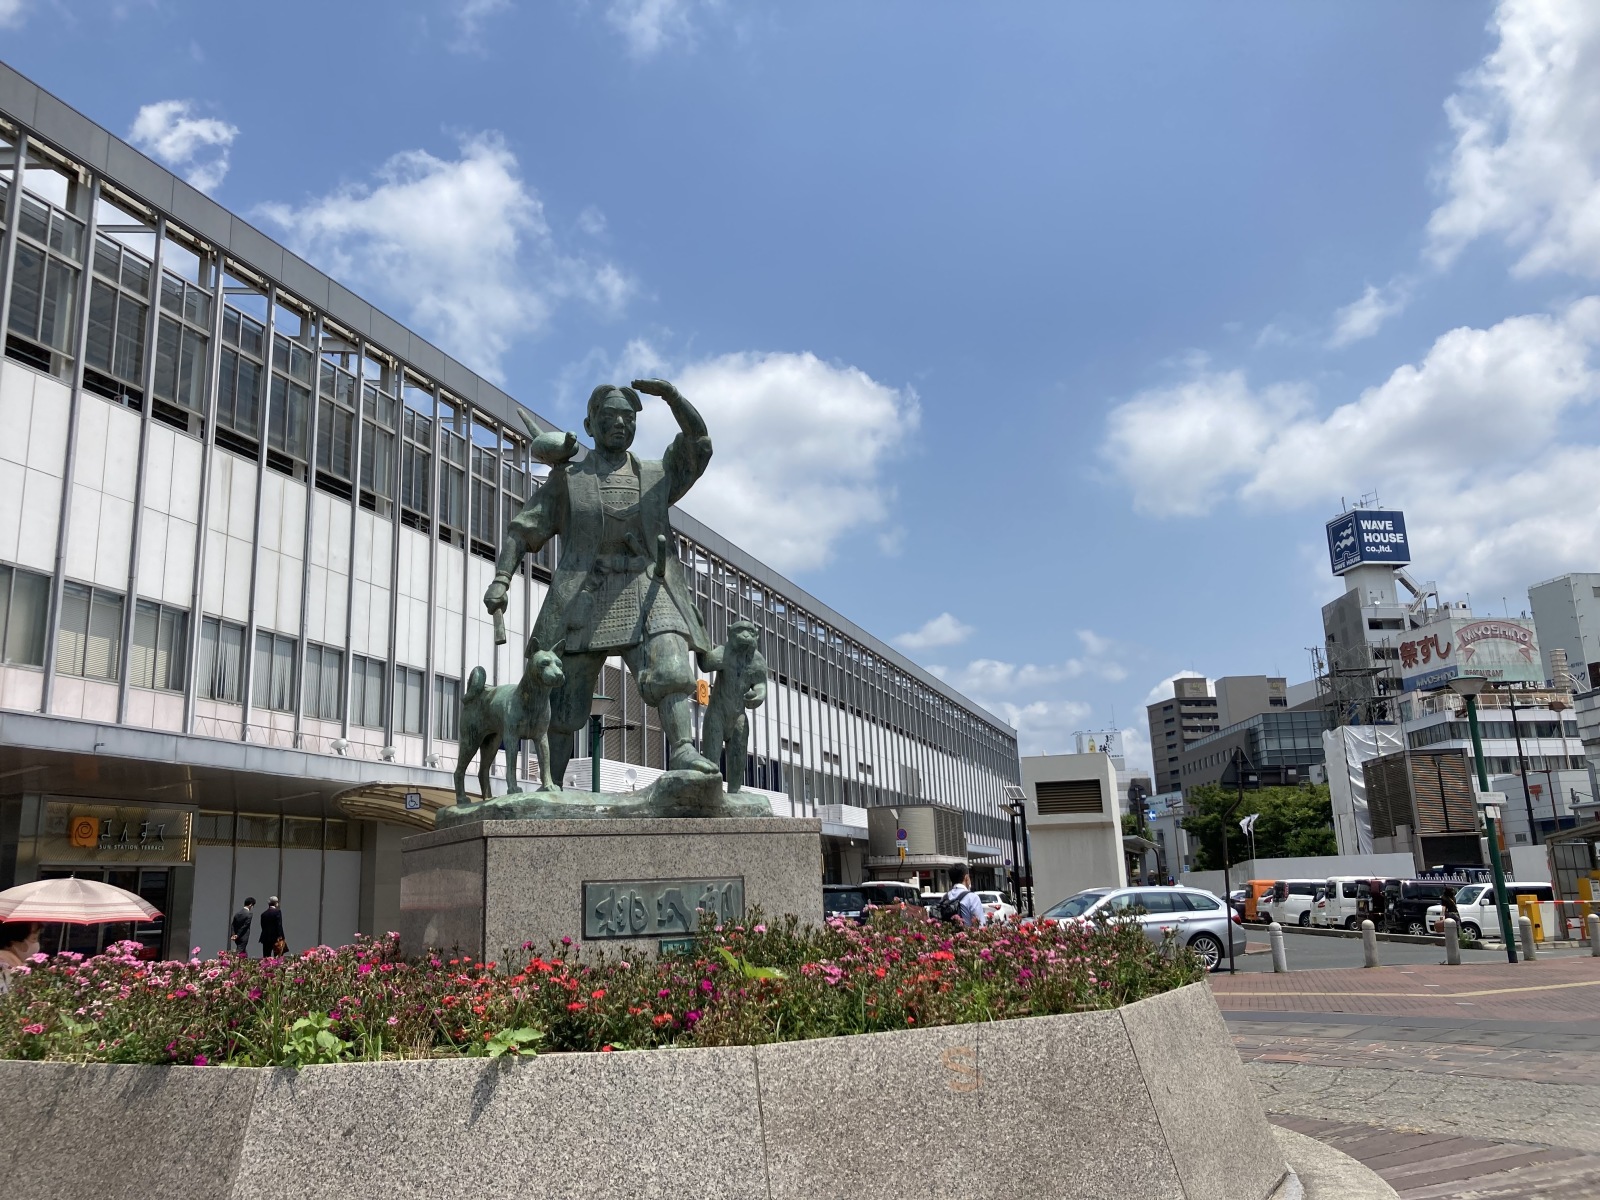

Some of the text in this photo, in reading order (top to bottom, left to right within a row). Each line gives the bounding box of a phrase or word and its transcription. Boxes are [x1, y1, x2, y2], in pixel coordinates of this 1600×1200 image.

[1360, 520, 1393, 530] WAVE
[1363, 532, 1404, 543] HOUSE
[1462, 624, 1529, 642] MIYOSHINO
[1399, 633, 1451, 668] 祭ずし
[1415, 670, 1456, 687] MIYOSHINO
[101, 819, 165, 844] さんすて
